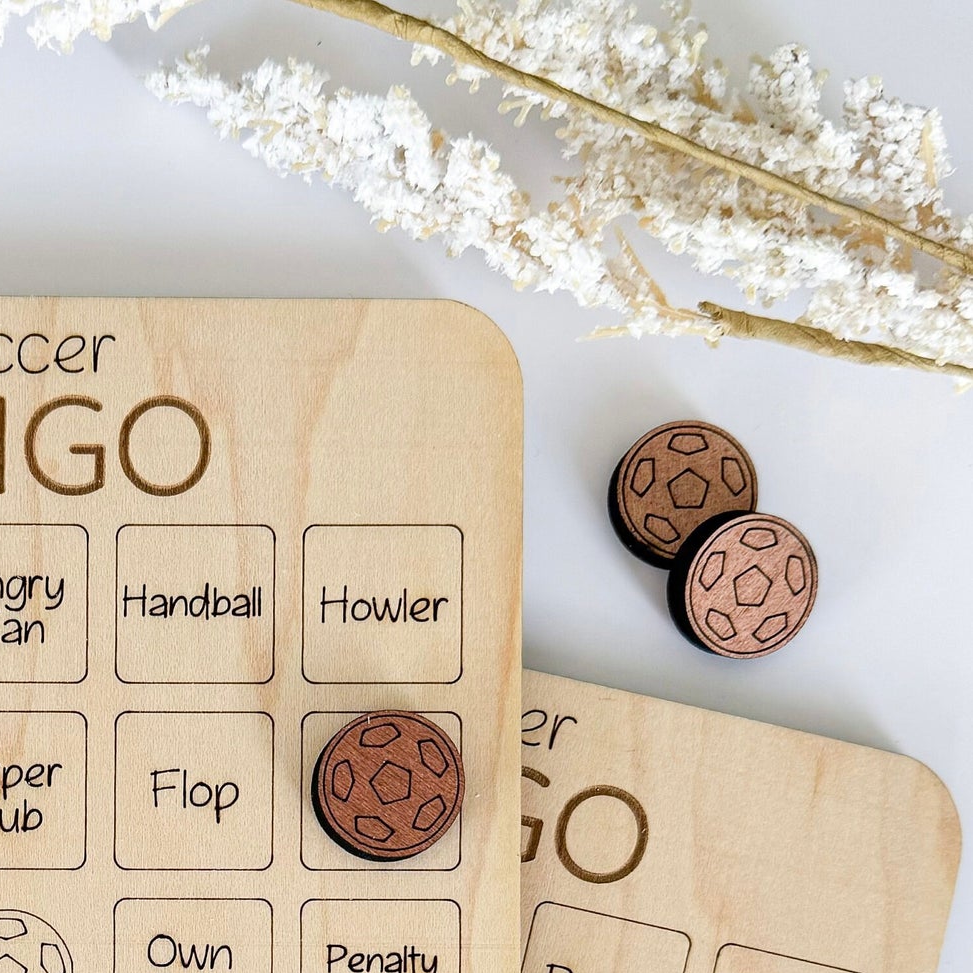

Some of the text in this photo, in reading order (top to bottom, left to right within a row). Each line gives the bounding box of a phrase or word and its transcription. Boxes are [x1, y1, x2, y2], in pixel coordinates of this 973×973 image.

[123, 582, 261, 620] Handball
[320, 585, 448, 623] Howler
[150, 768, 239, 824] Flop
[148, 934, 232, 970] Own
